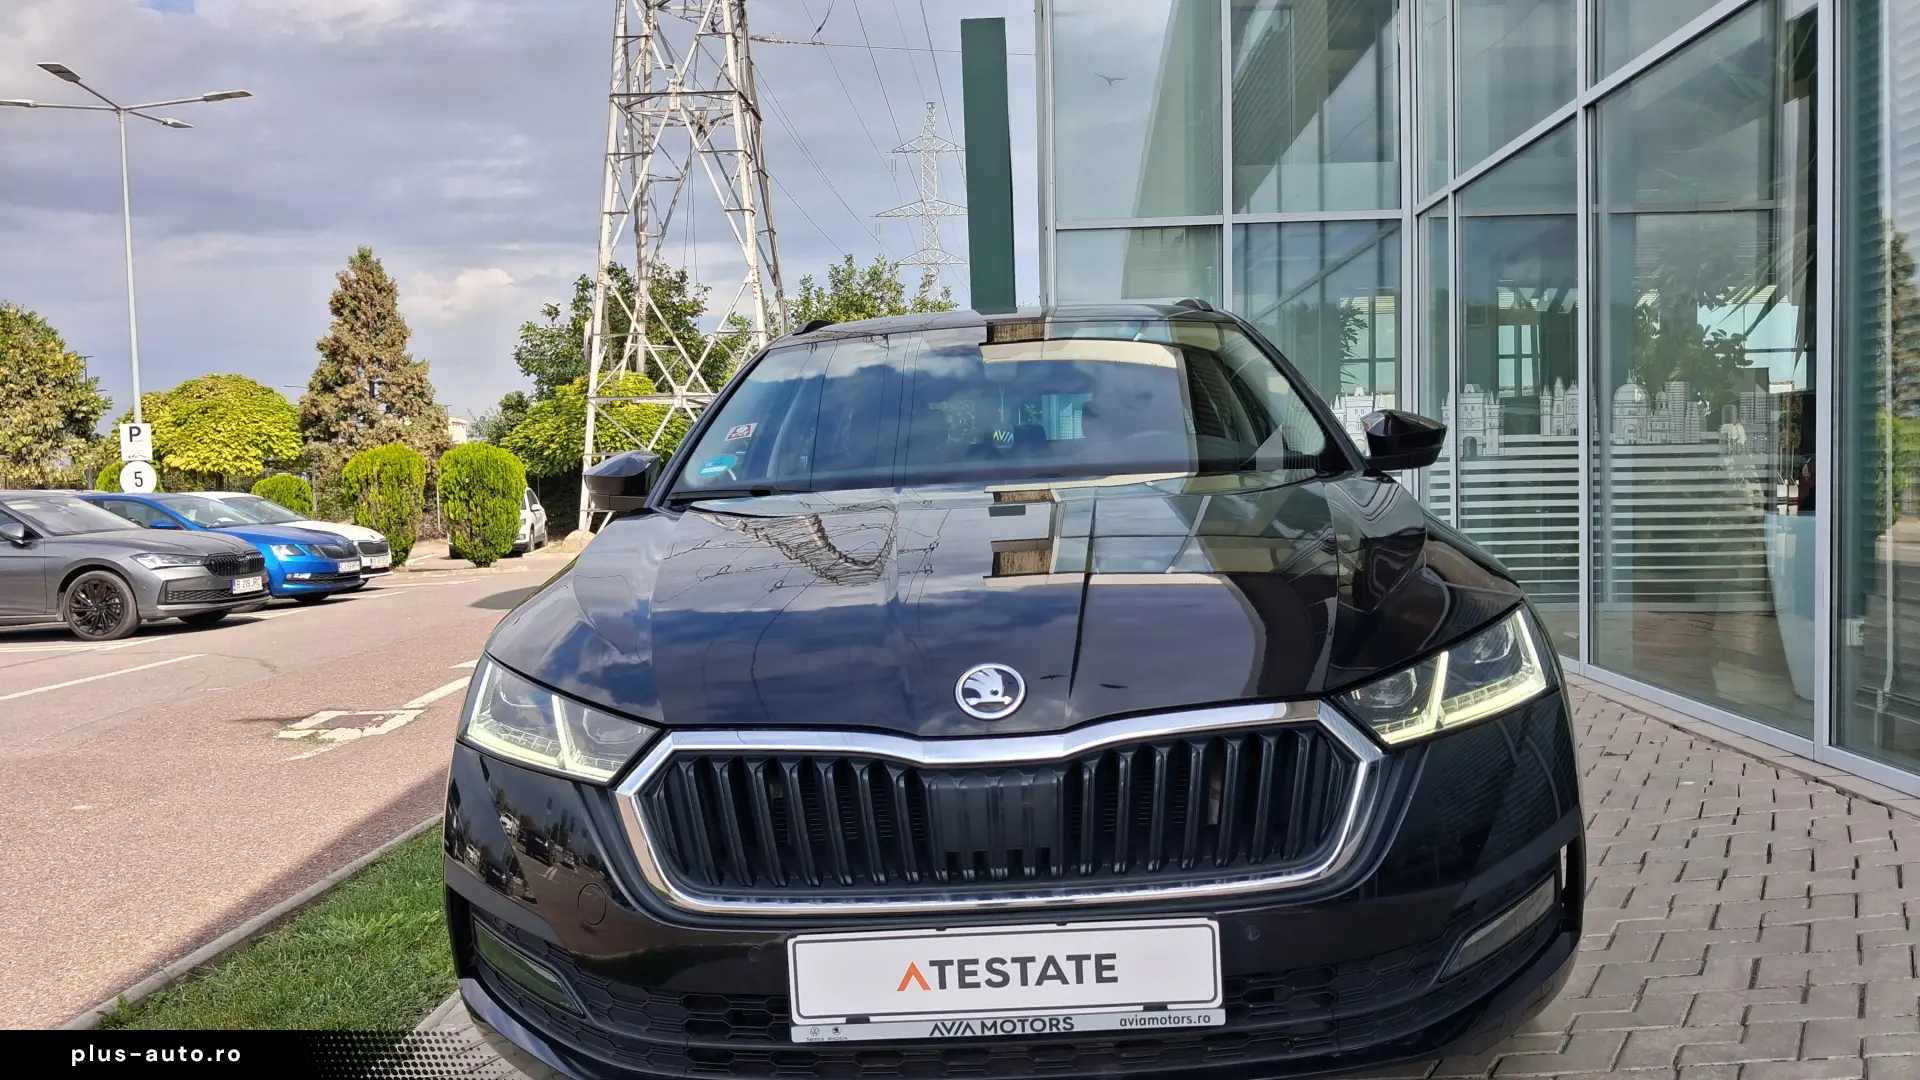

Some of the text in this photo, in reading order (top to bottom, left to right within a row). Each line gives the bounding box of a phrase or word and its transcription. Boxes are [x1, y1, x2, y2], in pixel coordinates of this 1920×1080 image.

[129, 426, 142, 443] P
[134, 471, 143, 488] 5
[980, 1016, 1076, 1036] MOTORS
[1119, 1012, 1212, 1028] aviamotors.ro
